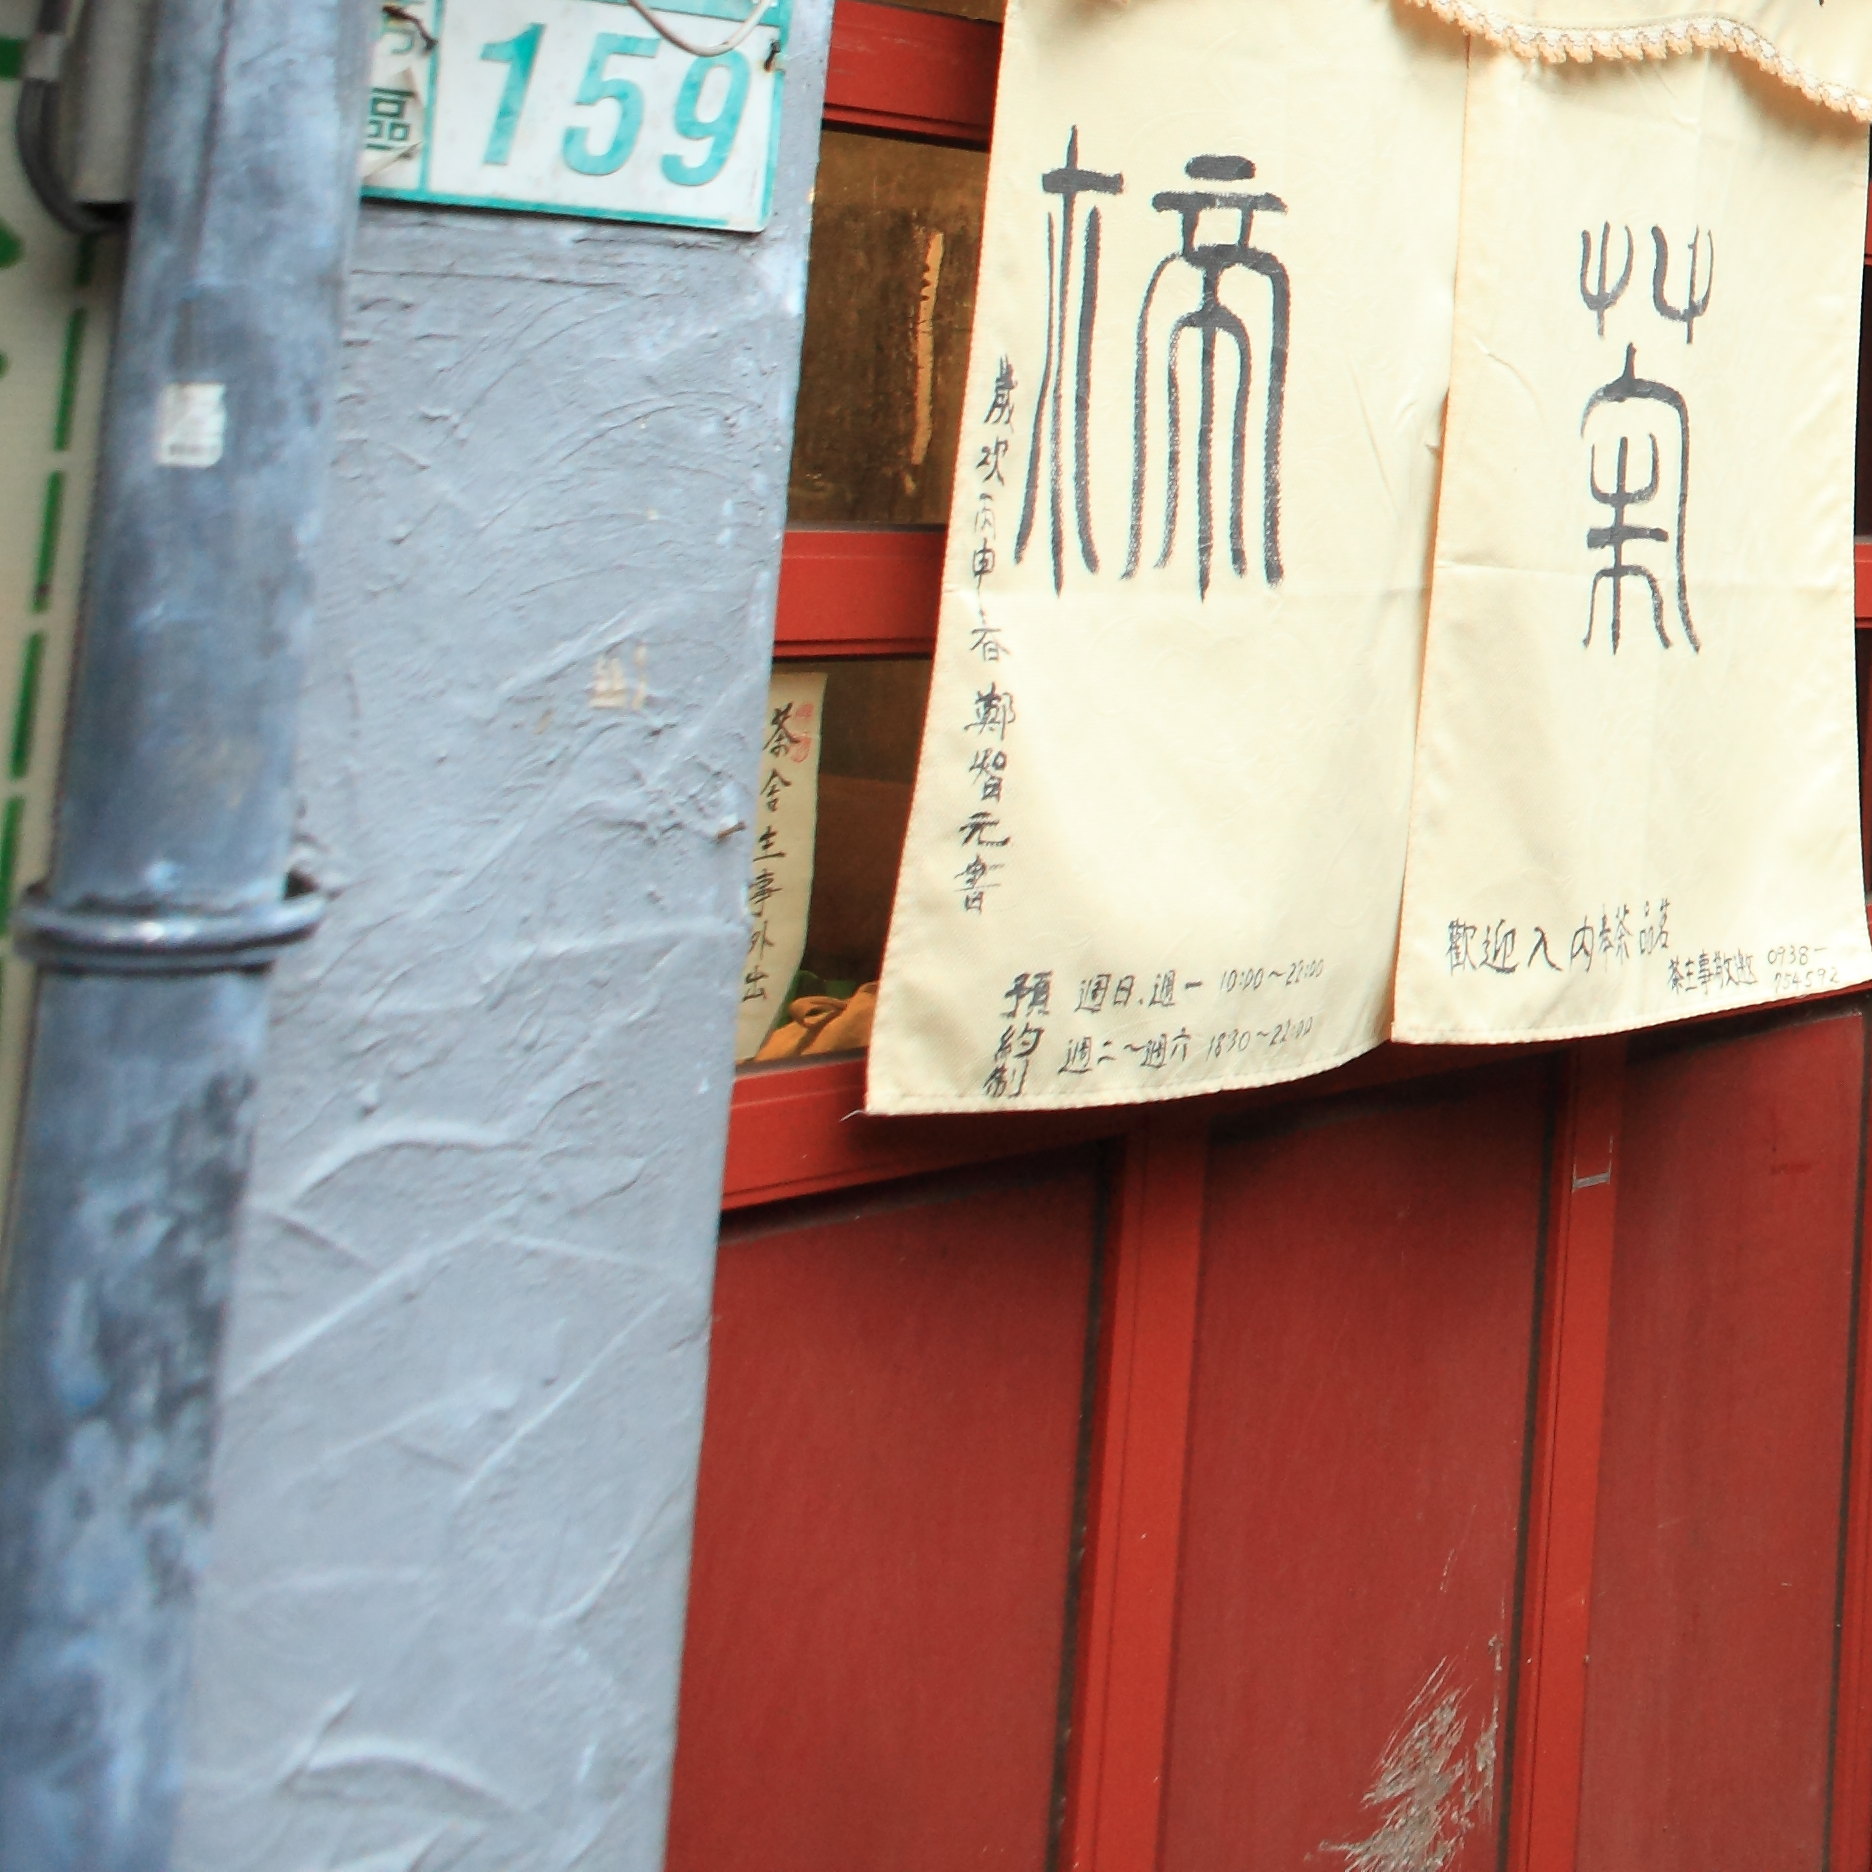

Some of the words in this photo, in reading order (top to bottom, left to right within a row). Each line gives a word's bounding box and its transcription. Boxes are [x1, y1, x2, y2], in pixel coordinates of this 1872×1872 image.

[480, 21, 752, 188] 159
[982, 970, 1054, 1099] 預約制
